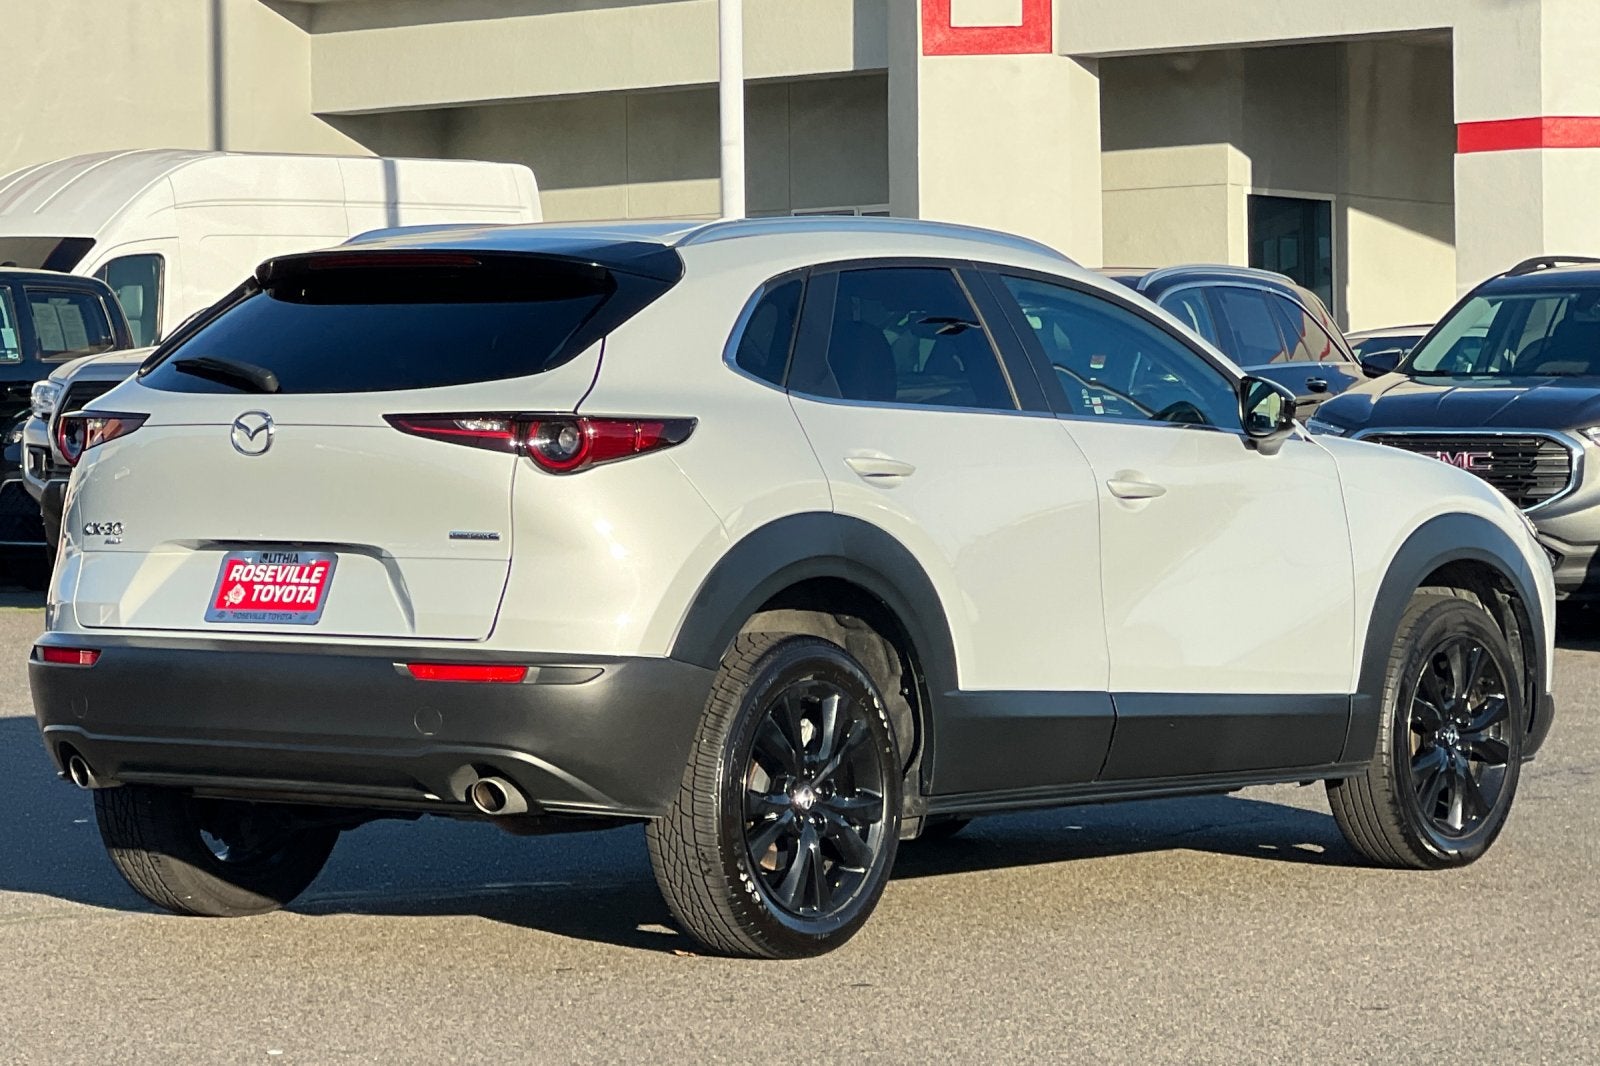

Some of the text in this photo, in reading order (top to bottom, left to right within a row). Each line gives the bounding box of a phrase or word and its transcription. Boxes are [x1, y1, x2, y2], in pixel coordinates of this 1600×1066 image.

[1419, 451, 1493, 470] MC
[268, 552, 299, 564] LITHIA
[228, 564, 325, 584] ROSEVILLE
[251, 584, 317, 604] TOYOTA
[232, 612, 292, 620] ROSEVILLE TOYOTA
